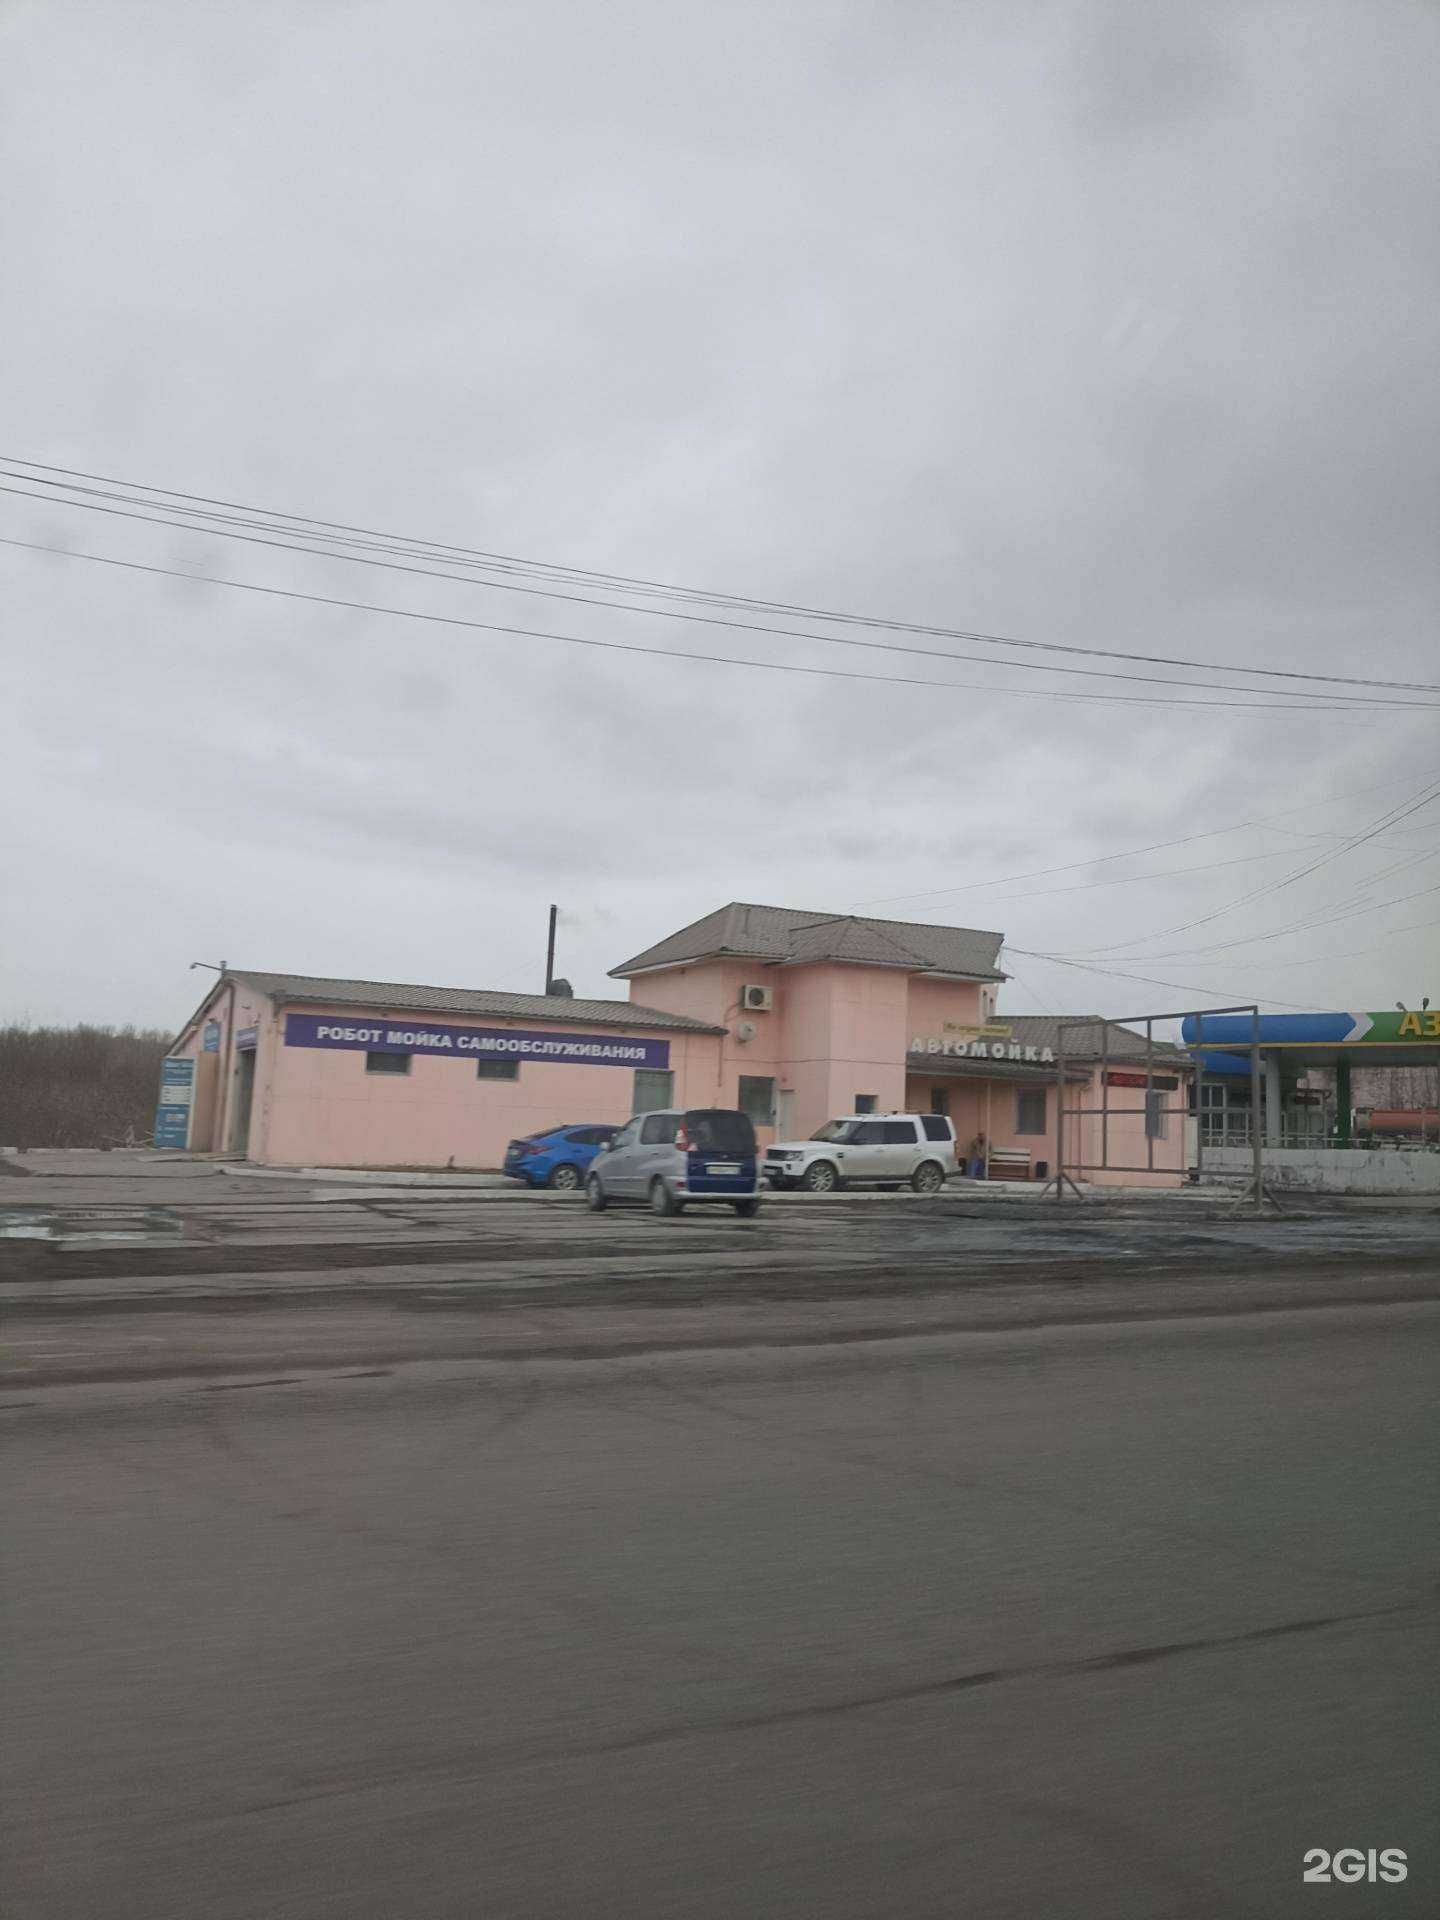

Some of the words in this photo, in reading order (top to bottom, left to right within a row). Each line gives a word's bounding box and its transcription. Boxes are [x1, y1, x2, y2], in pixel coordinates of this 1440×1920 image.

[317, 1026, 382, 1043] РОБОТ
[386, 1031, 452, 1048] МОЙКА
[457, 1036, 646, 1060] САМООБСЛУЖИВАНИЯ
[911, 1037, 1054, 1062] АВТОМОЙКА
